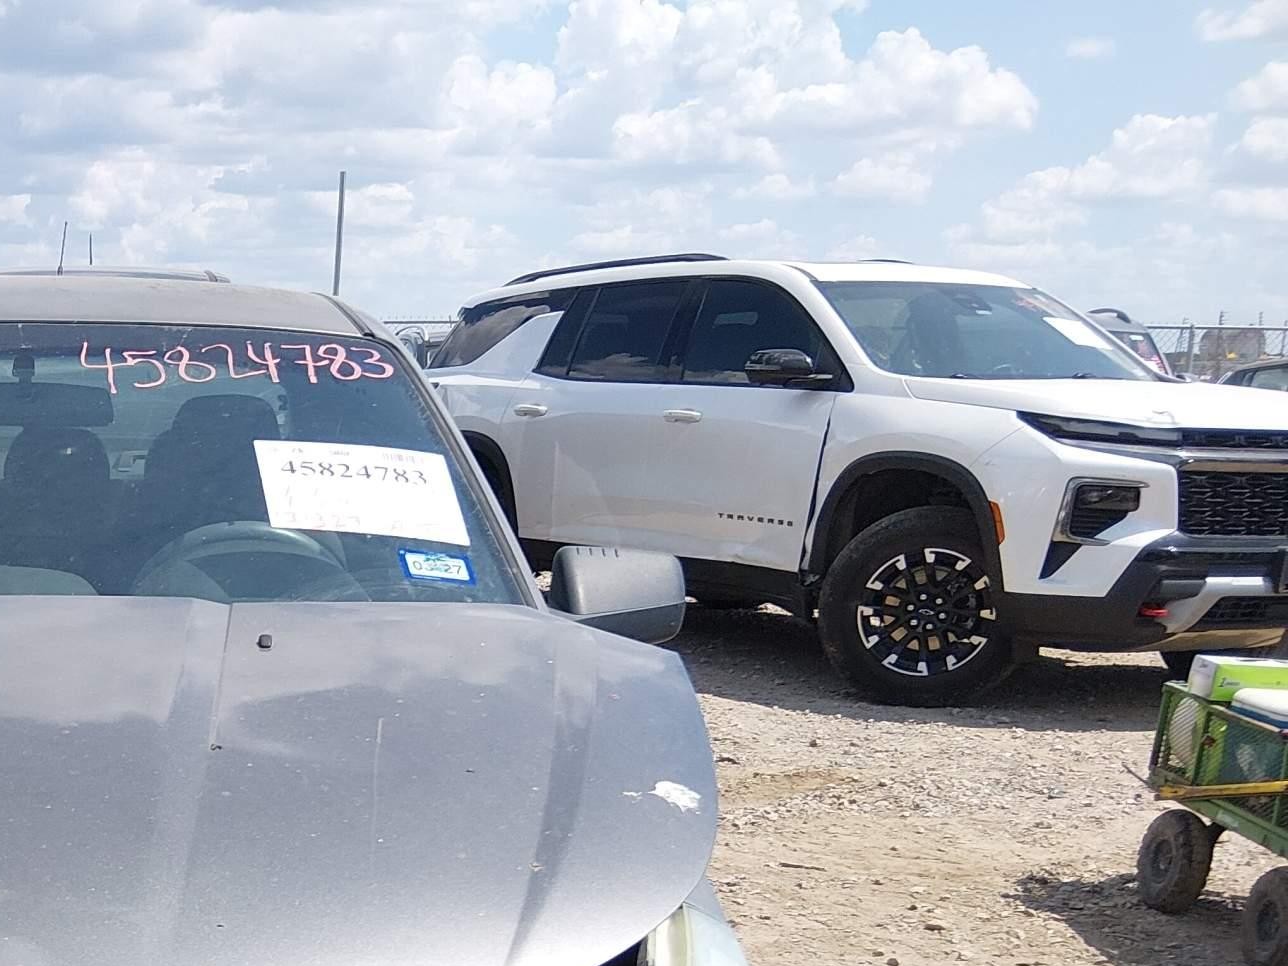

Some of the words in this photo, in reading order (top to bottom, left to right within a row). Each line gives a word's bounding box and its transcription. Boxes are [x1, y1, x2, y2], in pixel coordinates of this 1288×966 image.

[80, 341, 395, 394] 45824783
[281, 460, 428, 485] 45824783
[717, 512, 793, 527] TRAVERSE
